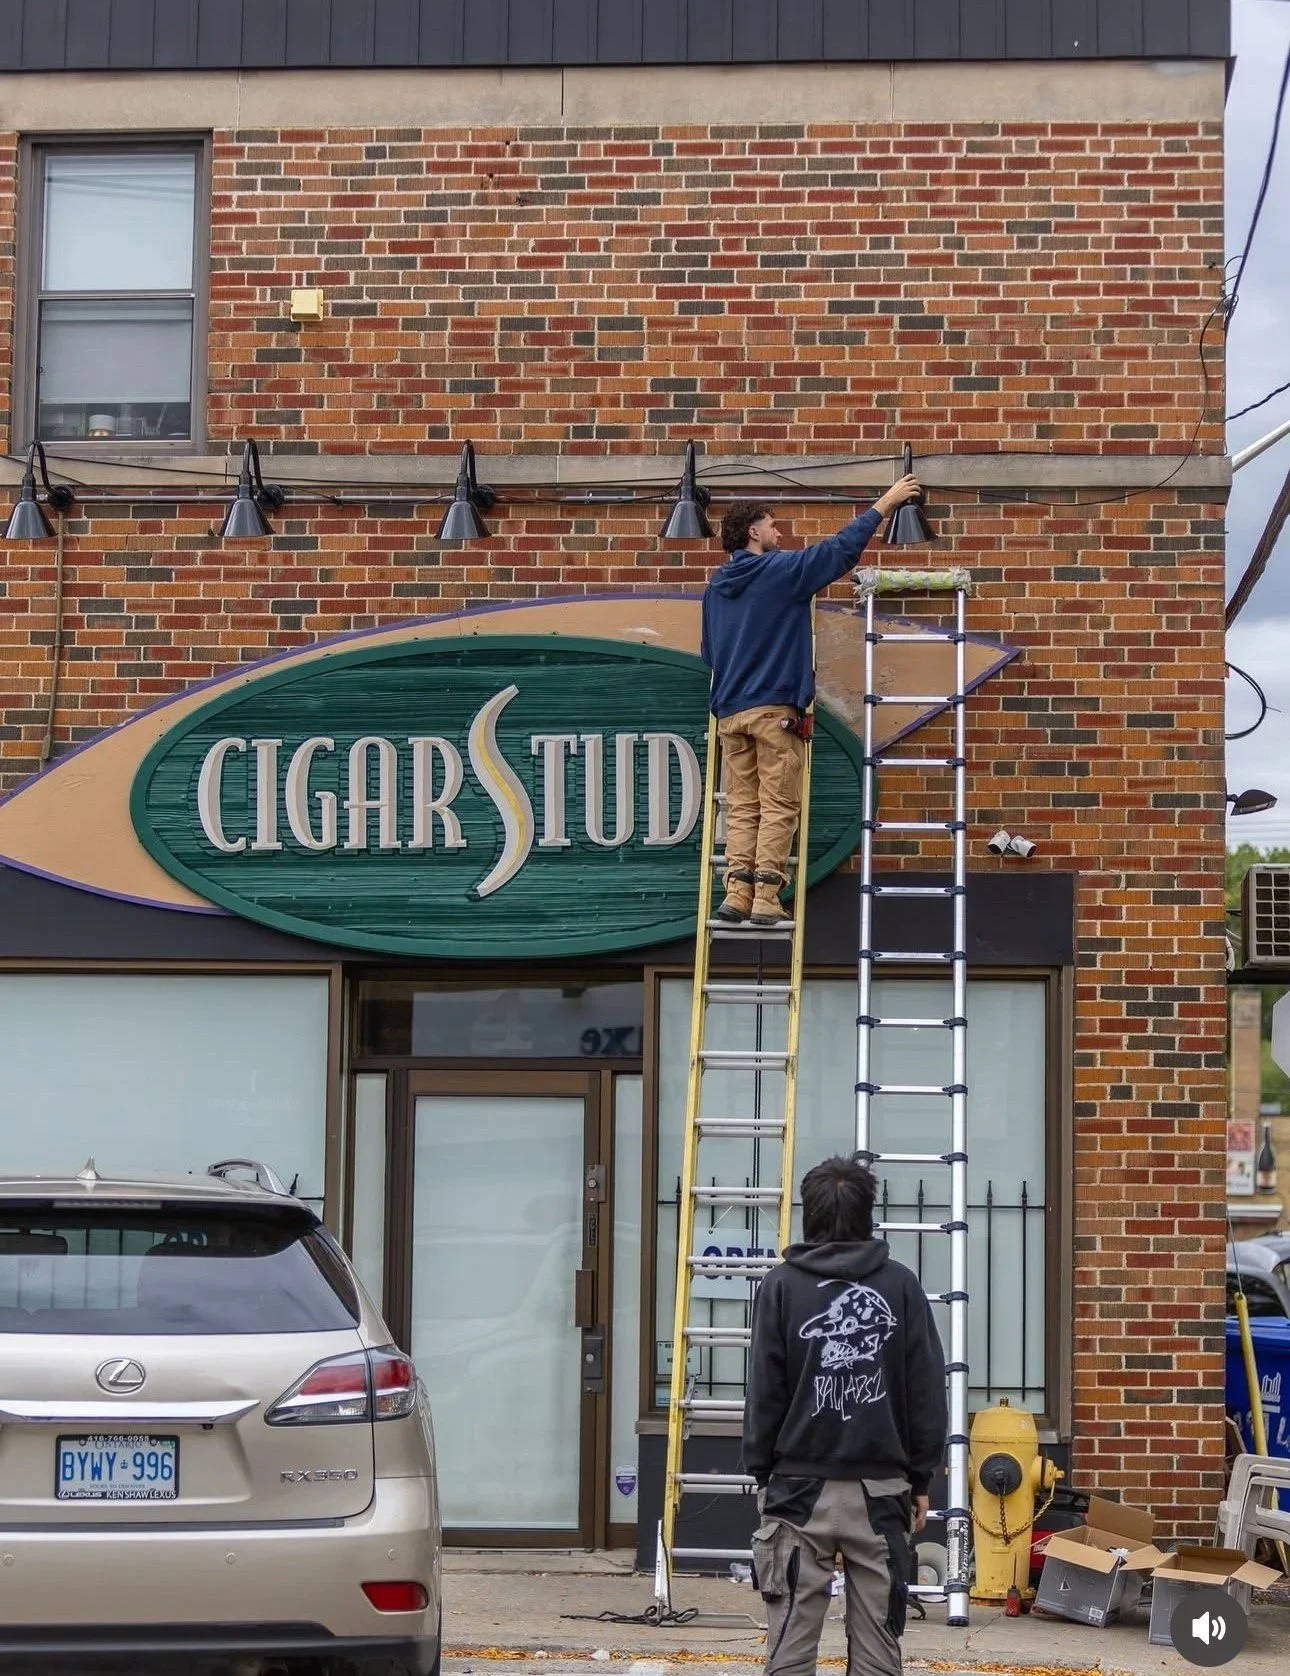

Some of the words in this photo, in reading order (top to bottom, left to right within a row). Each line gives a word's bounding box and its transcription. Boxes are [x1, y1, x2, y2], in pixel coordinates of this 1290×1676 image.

[196, 735, 467, 853] CIGAR
[467, 683, 800, 898] STUD
[702, 1246, 777, 1280] OPE
[62, 1451, 116, 1481] BYWY
[132, 1451, 173, 1481] 996
